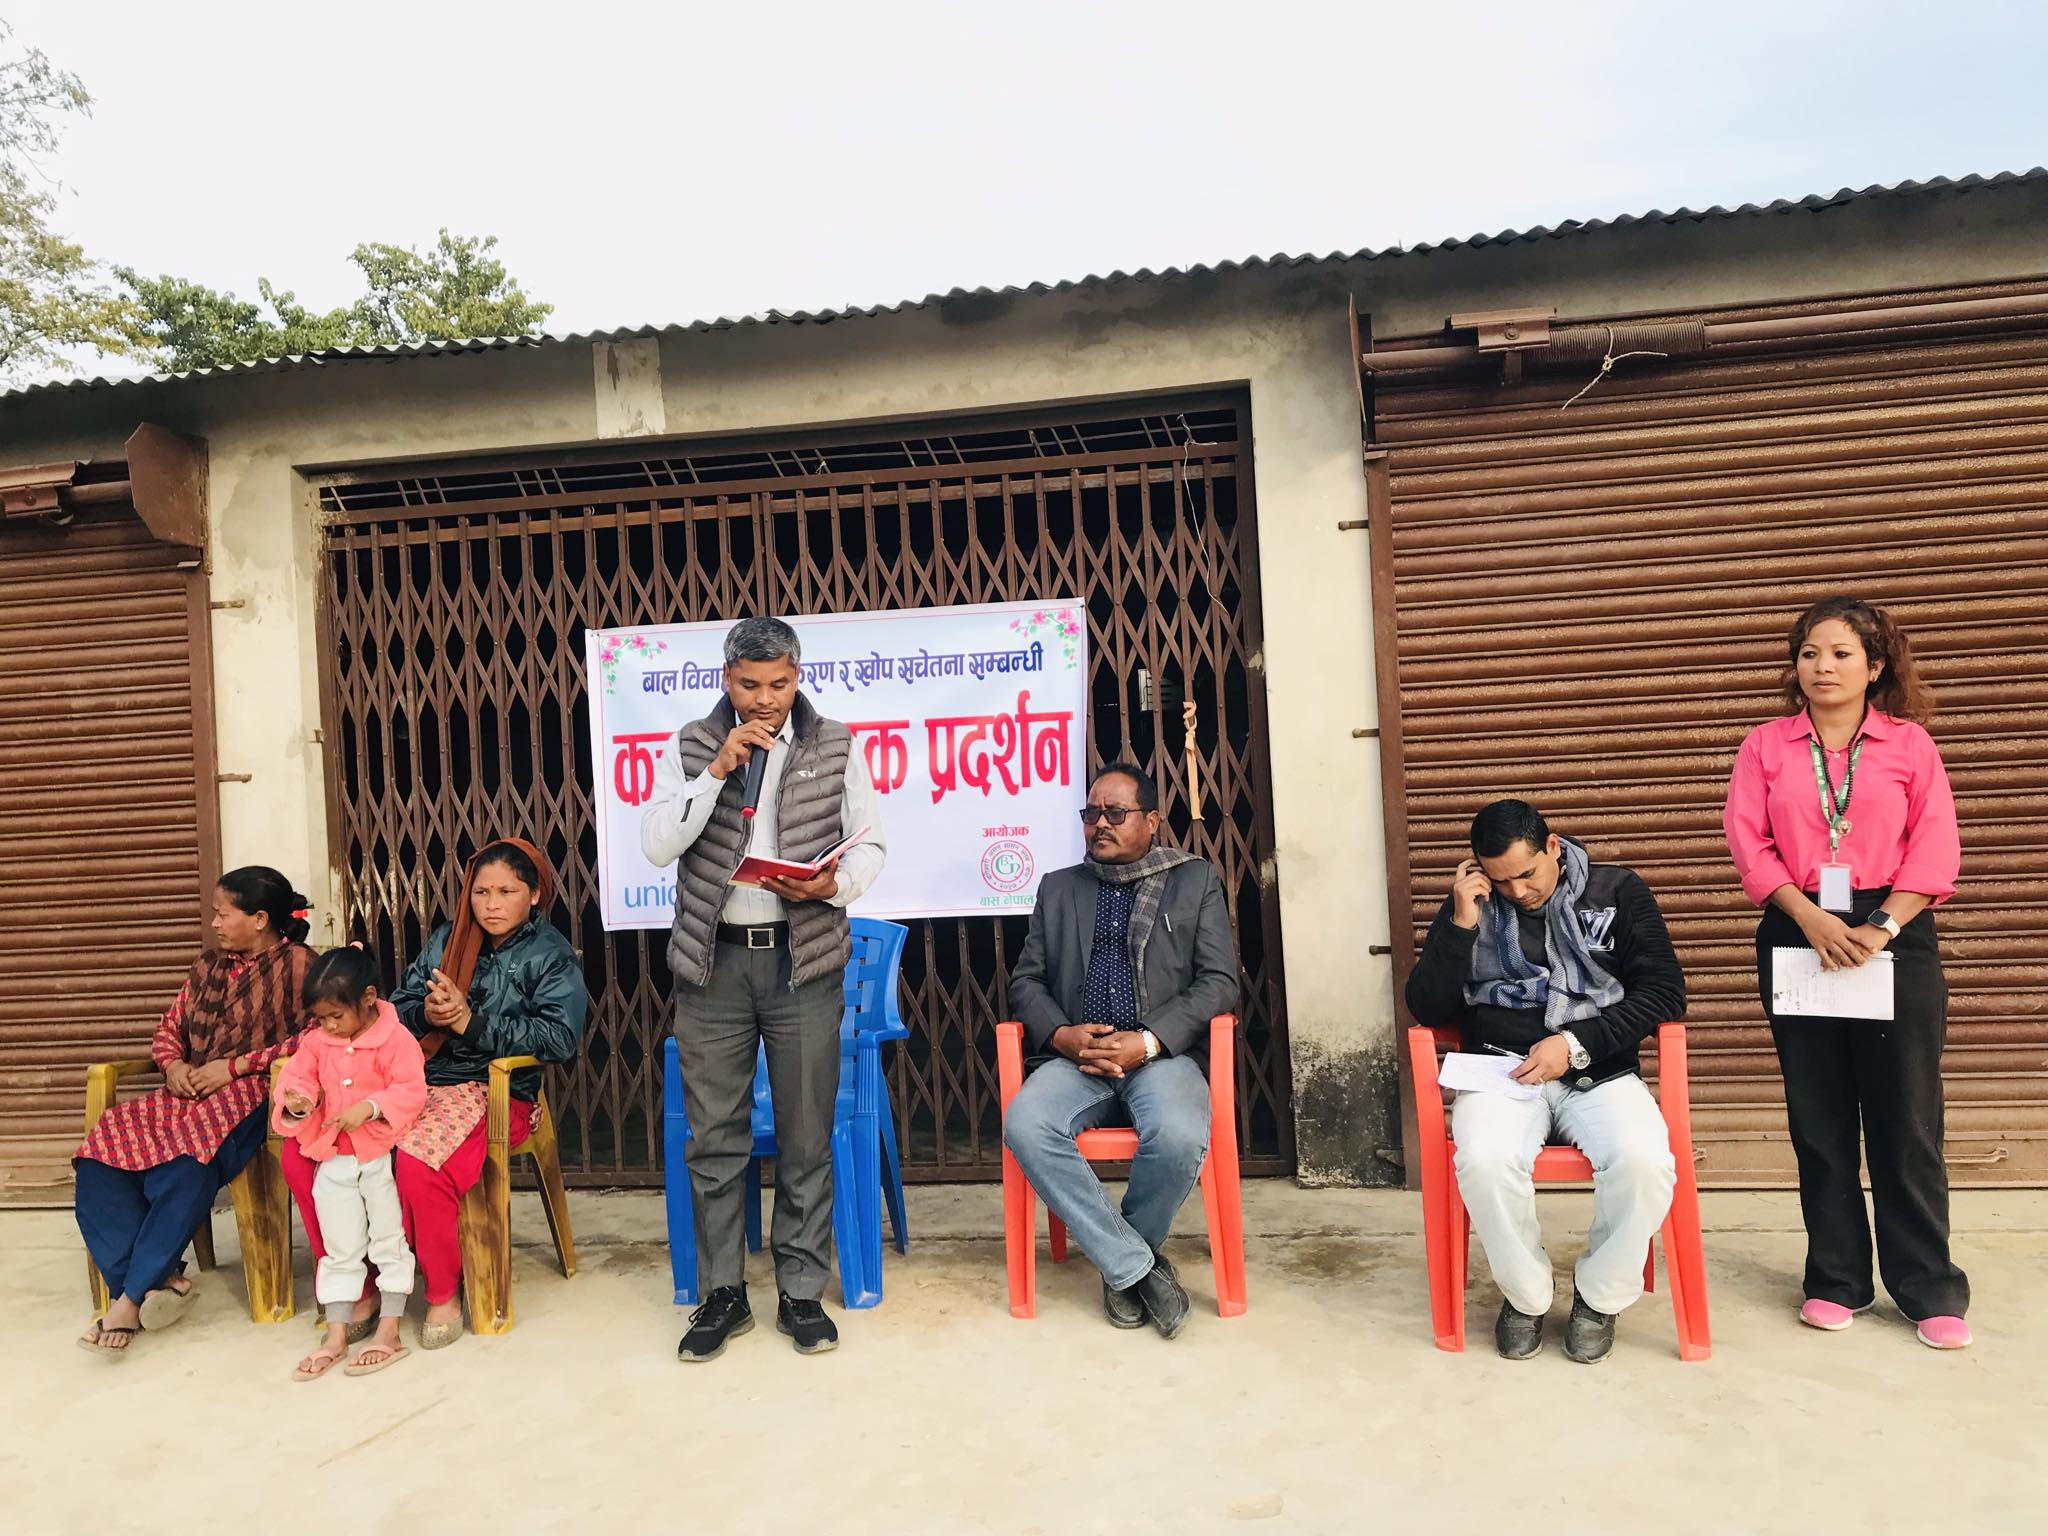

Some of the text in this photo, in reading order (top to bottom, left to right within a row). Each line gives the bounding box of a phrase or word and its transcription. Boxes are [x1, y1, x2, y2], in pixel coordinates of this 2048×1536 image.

[642, 670, 678, 696] बाल
[839, 660, 855, 692] र
[855, 651, 895, 687] खोप
[898, 648, 965, 685] सचेतना
[968, 641, 1044, 680] सम्बन्धी
[924, 689, 1074, 805] प्रदर्शन
[982, 824, 1030, 838] आयोजक
[624, 876, 677, 908] unic
